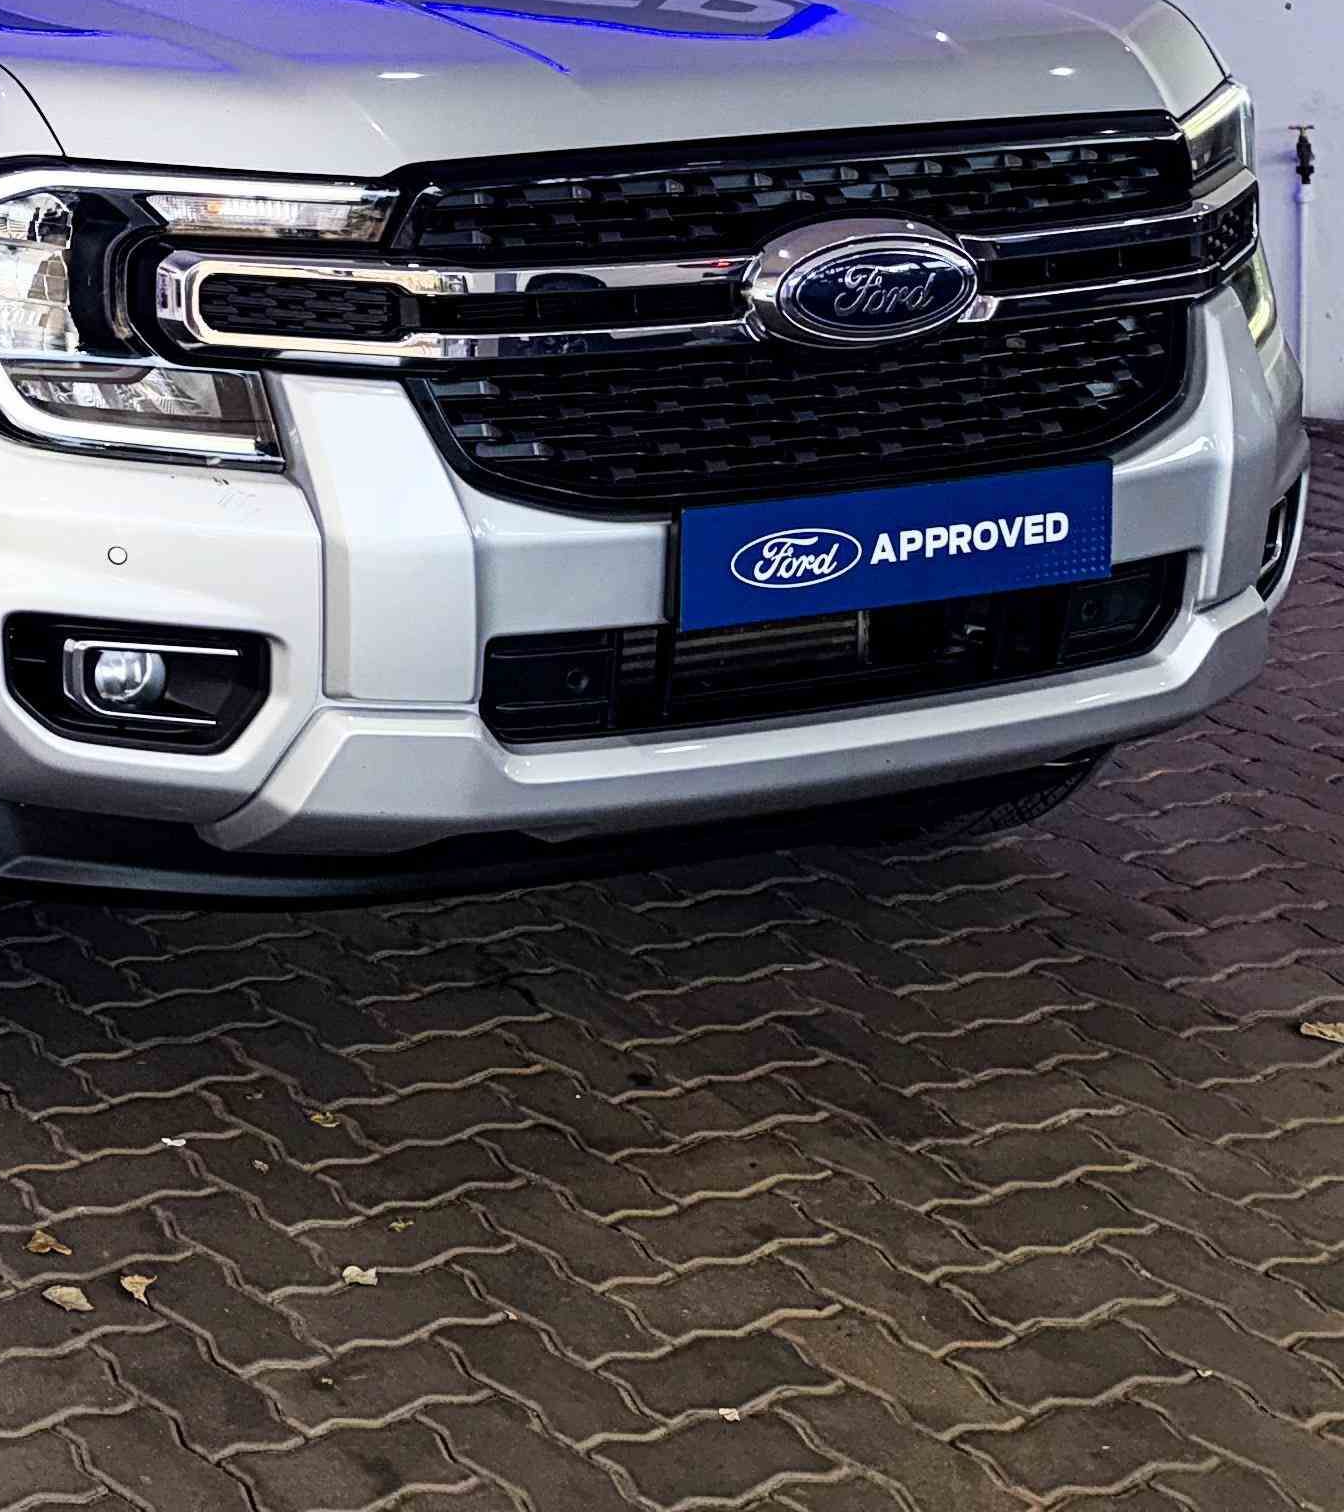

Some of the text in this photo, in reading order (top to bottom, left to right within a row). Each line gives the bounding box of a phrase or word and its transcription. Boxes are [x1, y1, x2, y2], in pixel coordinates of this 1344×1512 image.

[833, 265, 936, 316] Ford
[754, 511, 1070, 581] Ford APPROVED
